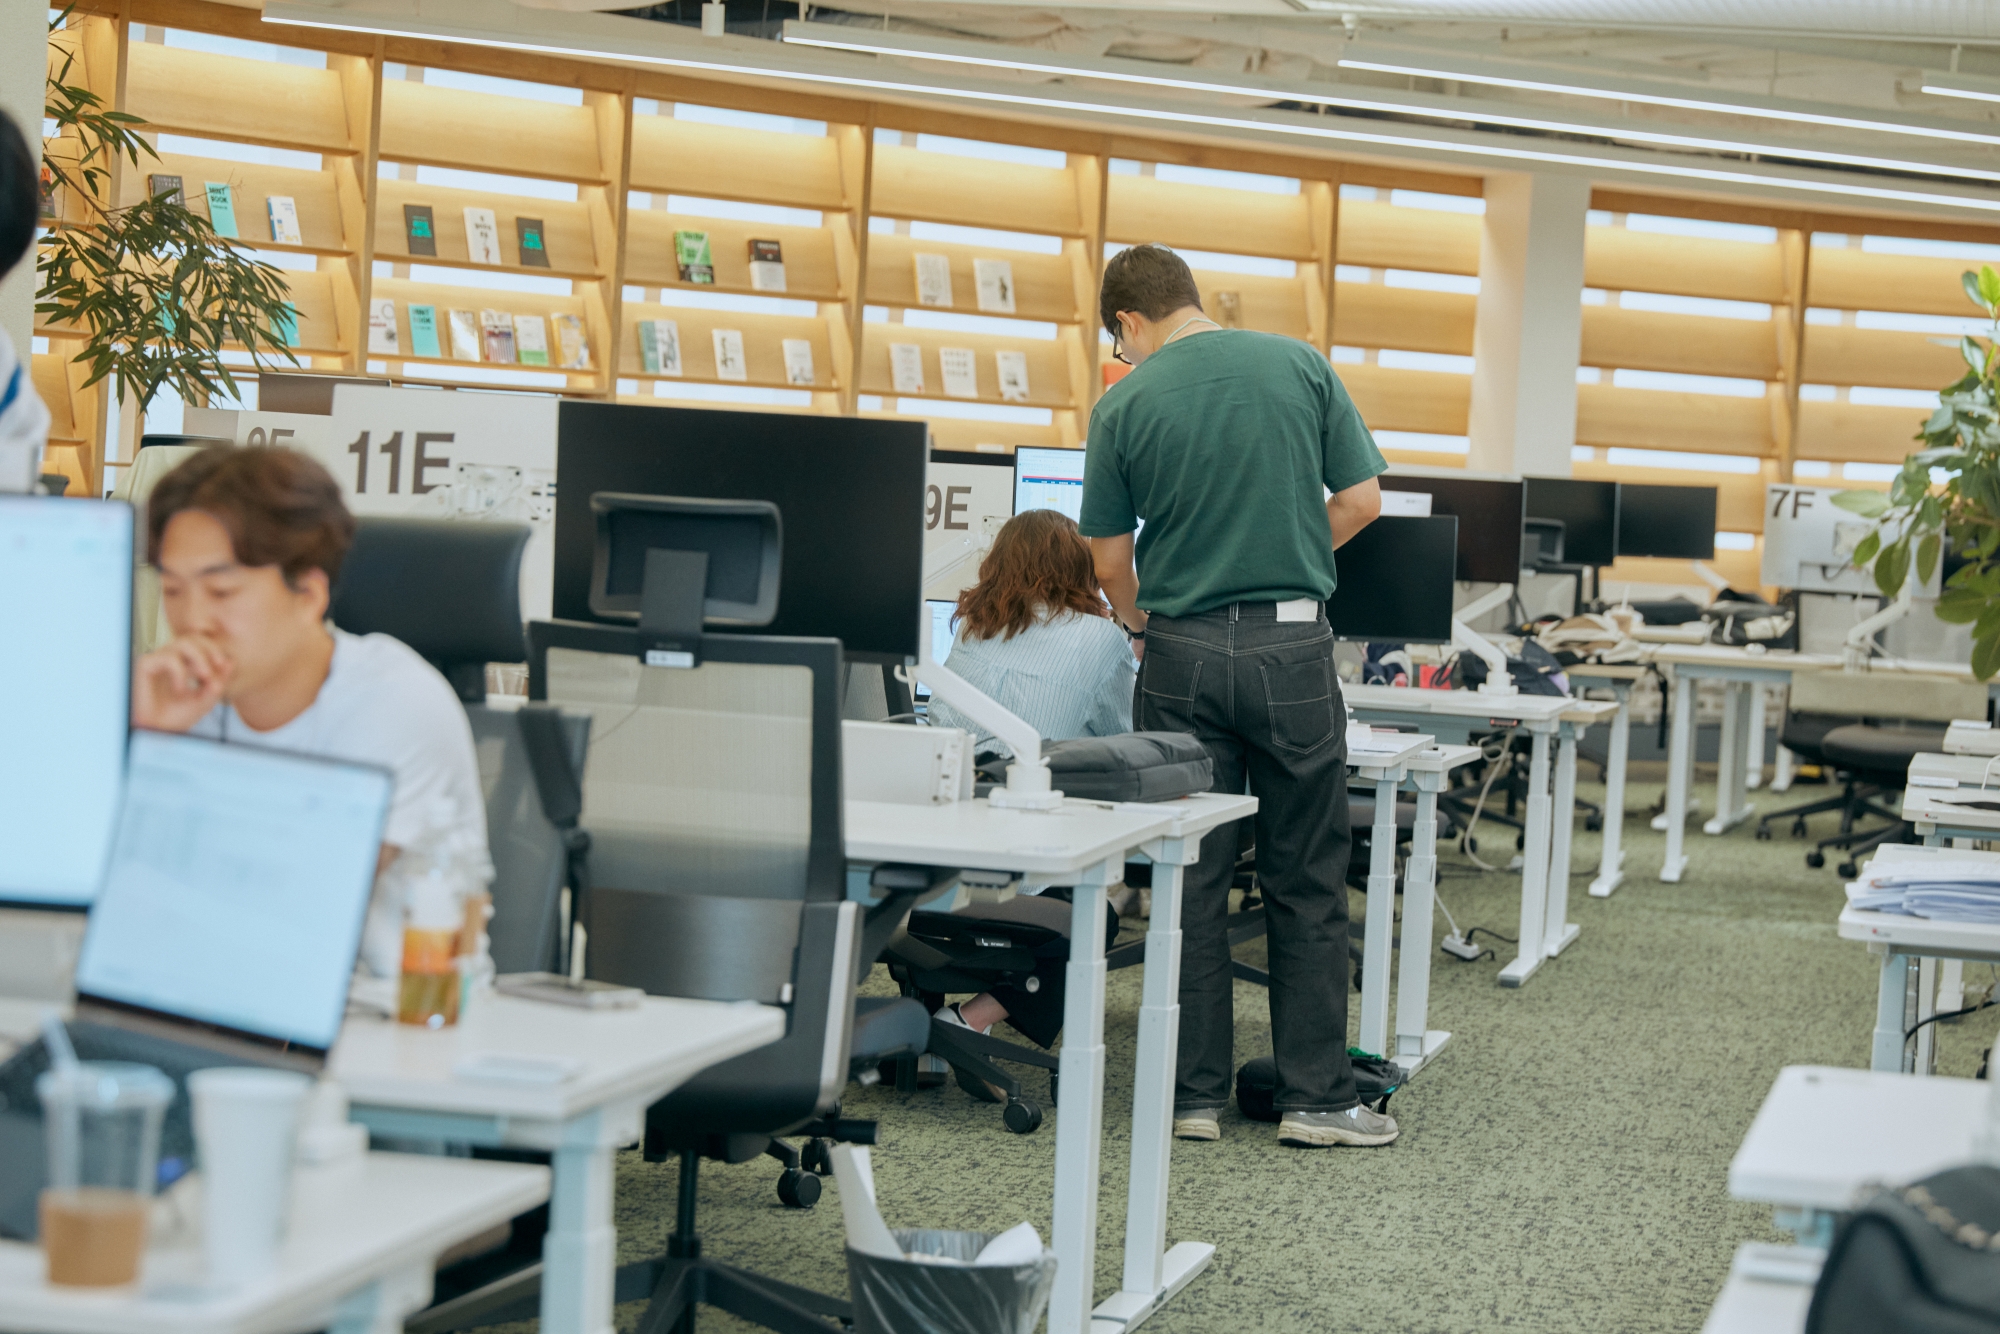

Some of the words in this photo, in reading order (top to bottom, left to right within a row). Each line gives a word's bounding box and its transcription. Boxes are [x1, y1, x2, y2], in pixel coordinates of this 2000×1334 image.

[348, 430, 455, 494] 11E
[924, 484, 972, 531] 9E
[1770, 488, 1815, 519] 7F
